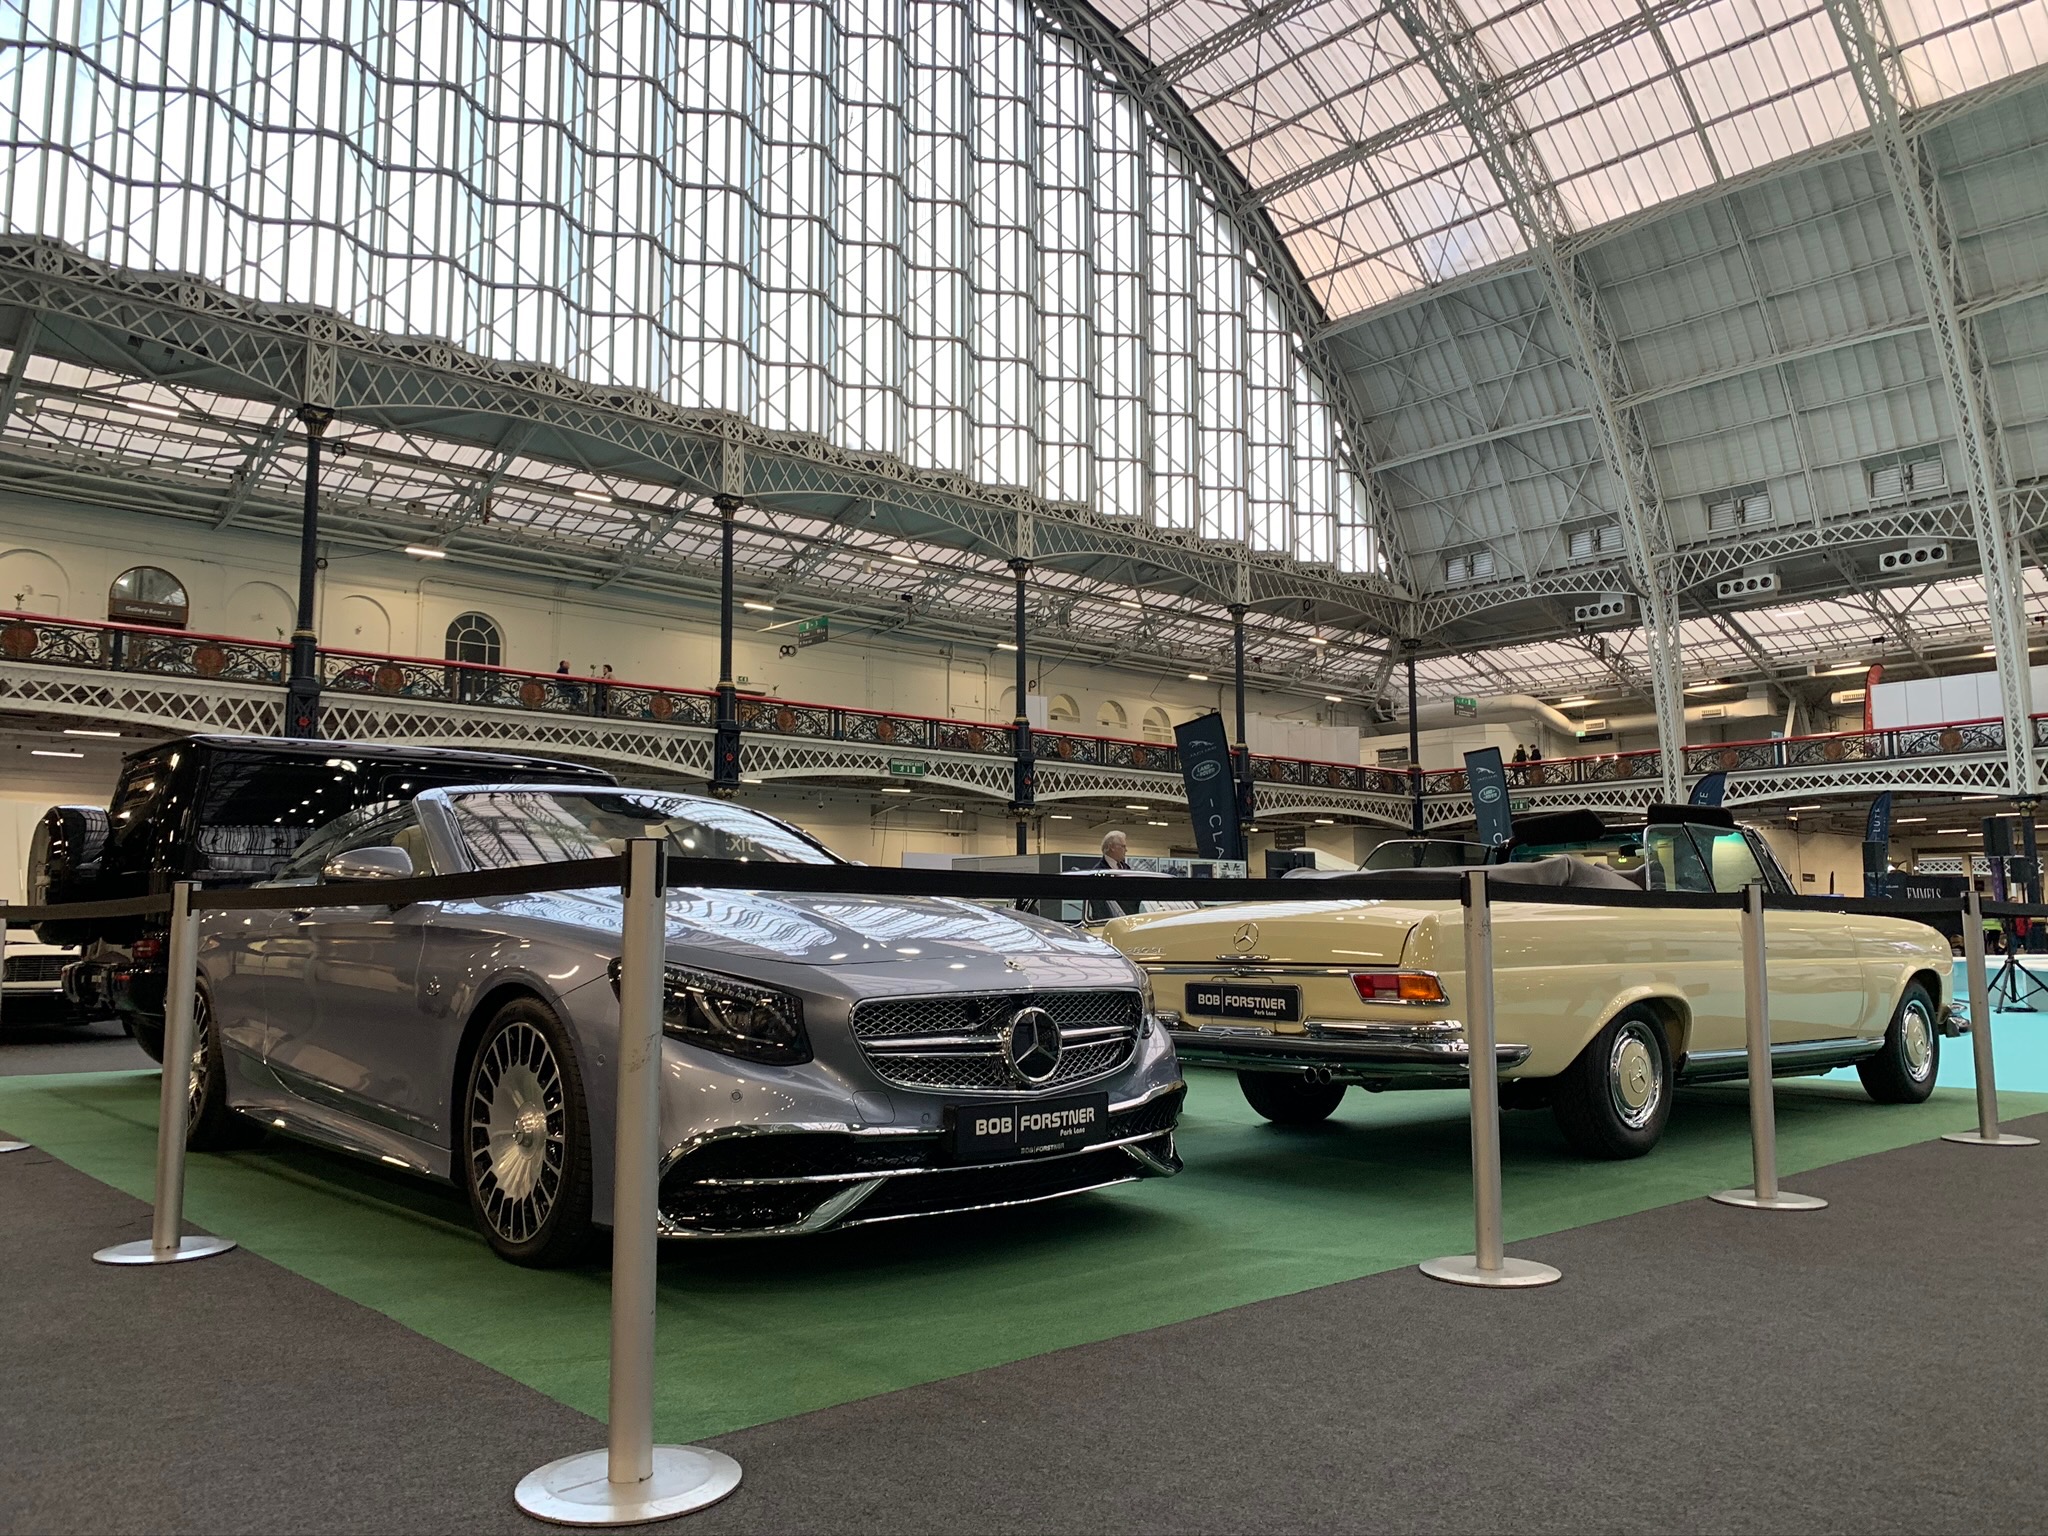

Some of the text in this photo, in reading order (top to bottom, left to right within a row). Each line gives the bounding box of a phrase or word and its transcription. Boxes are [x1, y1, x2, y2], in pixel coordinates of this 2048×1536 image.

[125, 605, 148, 614] Gallery
[1197, 993, 1286, 1010] BOB FORSTNER
[975, 1106, 1095, 1136] BOB FORSTNER
[1060, 1128, 1073, 1137] Park
